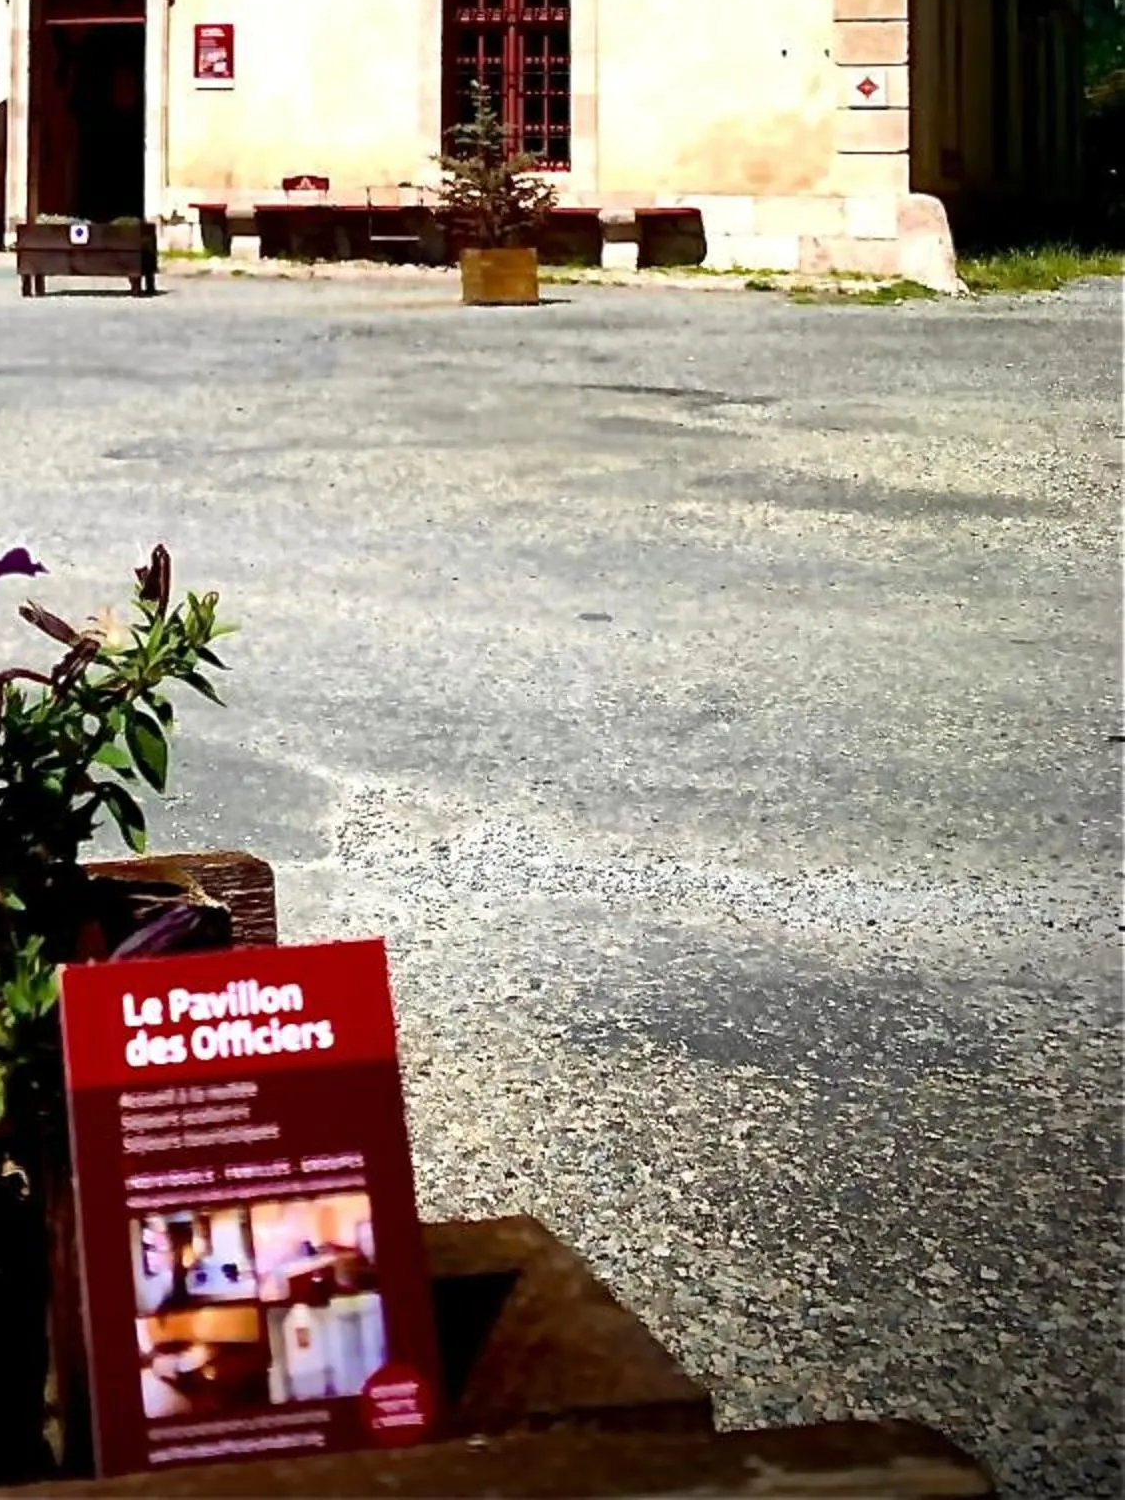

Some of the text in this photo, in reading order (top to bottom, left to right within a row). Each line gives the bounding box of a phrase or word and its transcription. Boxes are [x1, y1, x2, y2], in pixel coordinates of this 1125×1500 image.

[122, 978, 303, 1027] Le Pavillon
[126, 1017, 334, 1067] des Officiers
